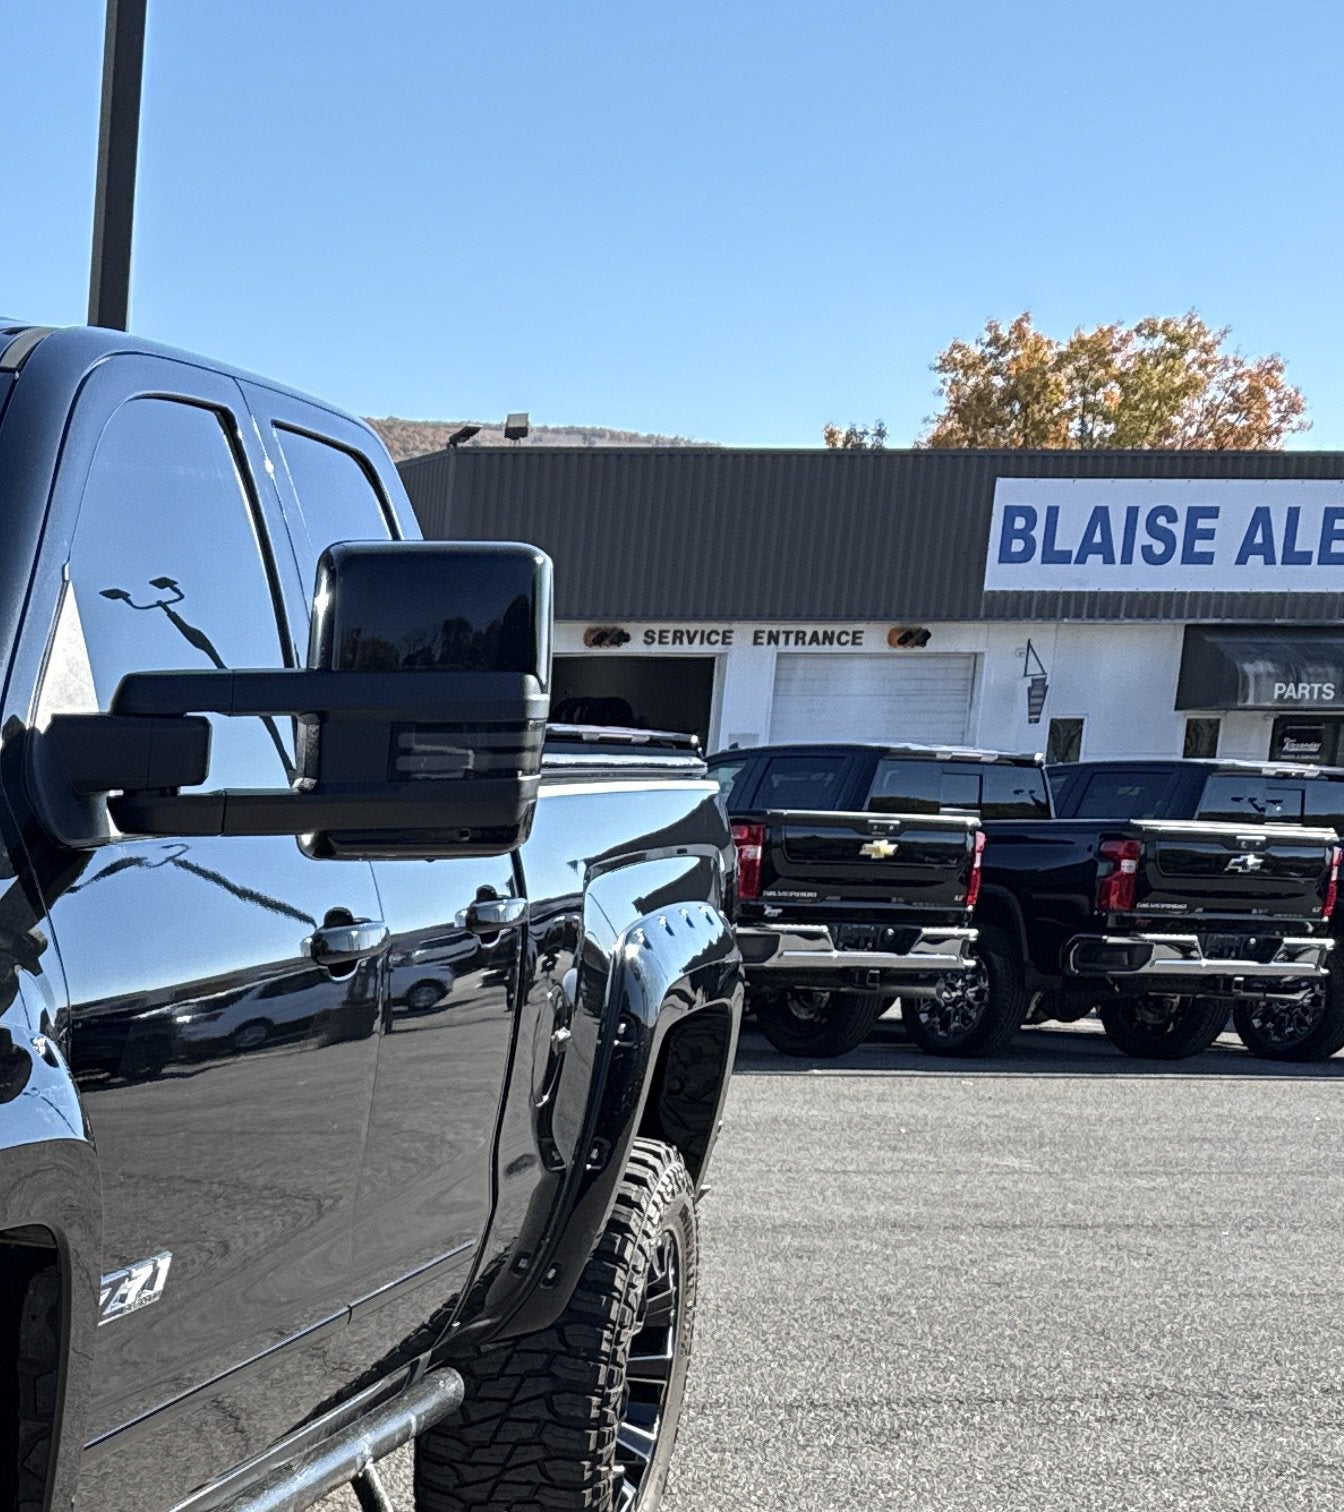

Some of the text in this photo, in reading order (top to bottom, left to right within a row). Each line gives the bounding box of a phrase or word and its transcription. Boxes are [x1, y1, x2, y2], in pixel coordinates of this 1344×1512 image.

[997, 504, 1220, 566] BLAISE
[642, 629, 864, 647] SERVICE ENTRANCE
[1273, 682, 1335, 701] PARTS
